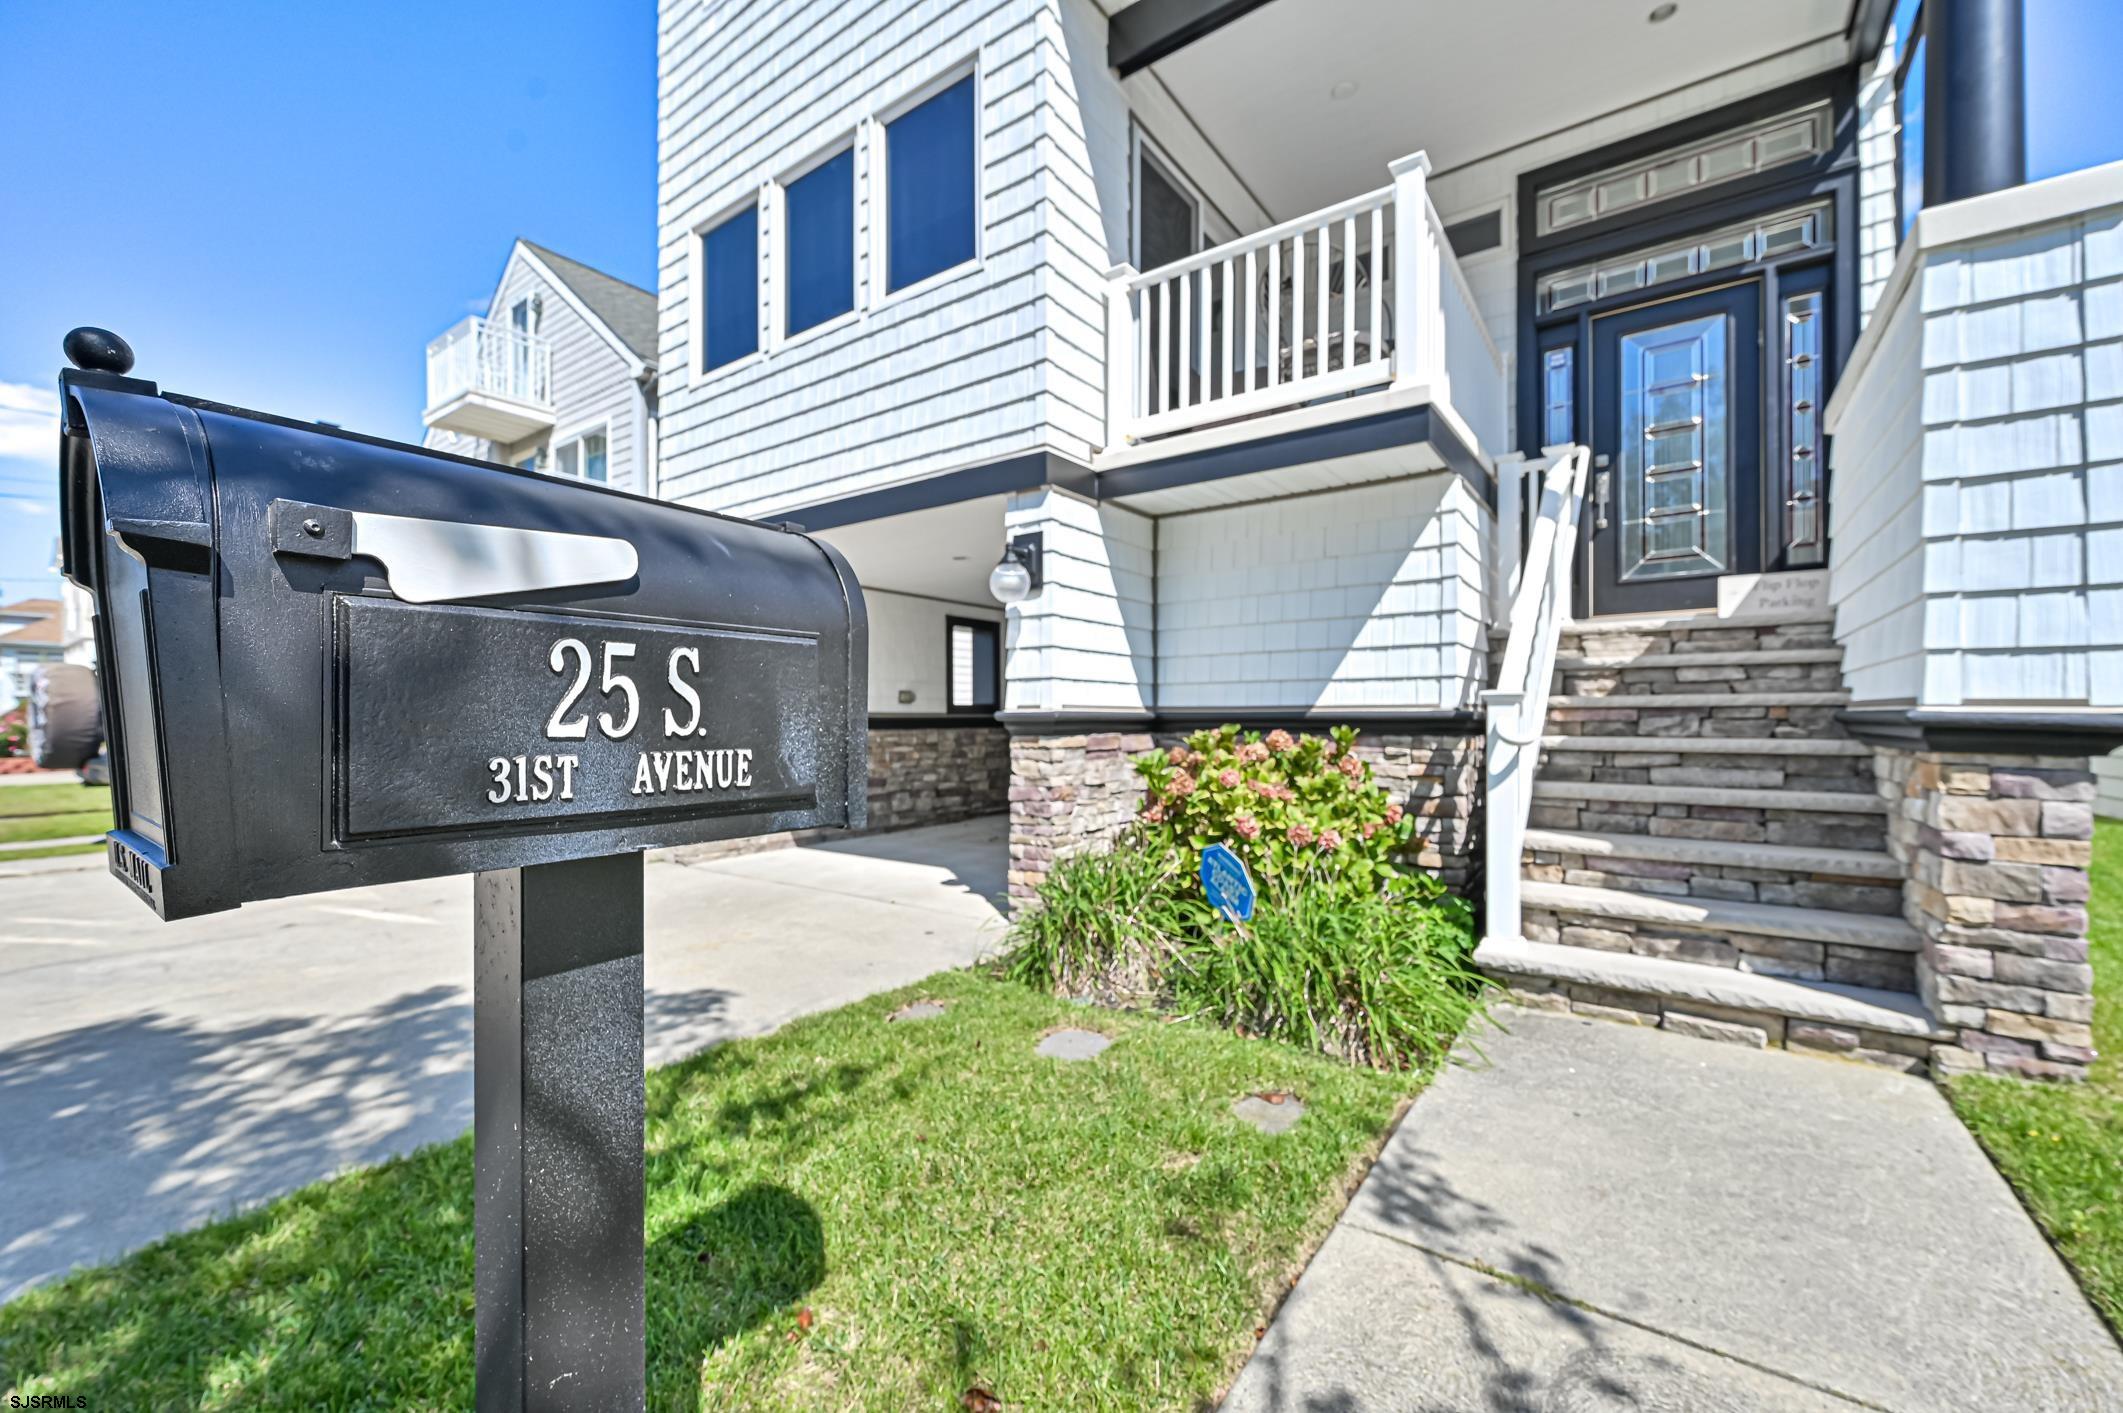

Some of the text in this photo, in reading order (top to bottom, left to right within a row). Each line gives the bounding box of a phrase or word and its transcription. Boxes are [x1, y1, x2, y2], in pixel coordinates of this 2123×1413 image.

[1786, 577, 1820, 590] Flop
[1758, 595, 1815, 609] Parking
[546, 638, 707, 739] 25 S.
[487, 748, 753, 804] 31ST AVENUE
